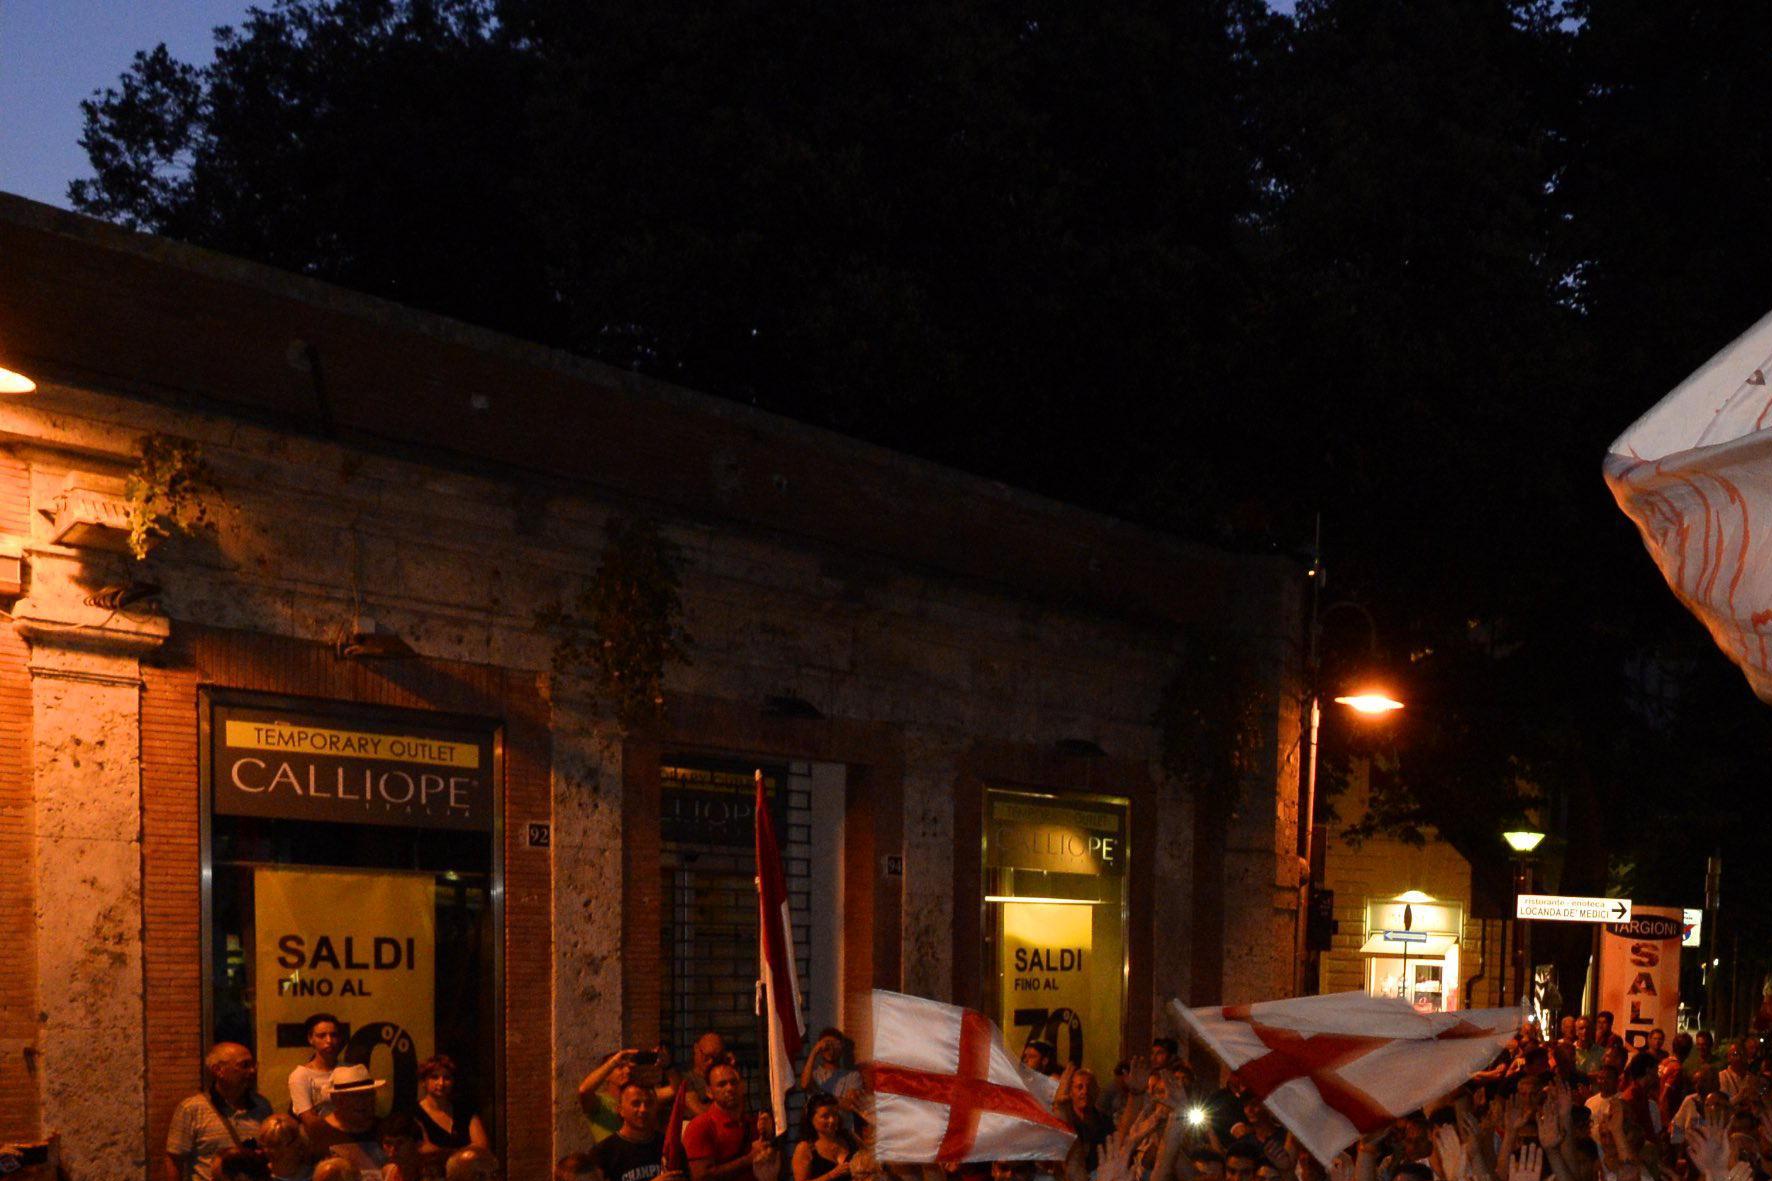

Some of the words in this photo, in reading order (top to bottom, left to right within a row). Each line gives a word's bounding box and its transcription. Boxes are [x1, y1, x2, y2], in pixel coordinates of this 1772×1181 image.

[254, 728, 382, 755] TEMPORARY
[389, 740, 456, 762] OUTLET
[231, 757, 471, 809] CALLIOPE
[530, 827, 548, 843] 92
[1520, 907, 1561, 917] LOCANDA
[1579, 908, 1609, 919] MEDICI
[1571, 899, 1605, 908] enoteca
[277, 934, 415, 971] SALDI
[1014, 947, 1082, 972] SALDI
[278, 978, 334, 997] FINO
[340, 979, 372, 997] AL
[1014, 977, 1040, 991] FINO
[1043, 978, 1059, 991] AL
[1625, 942, 1660, 1050] SALD
